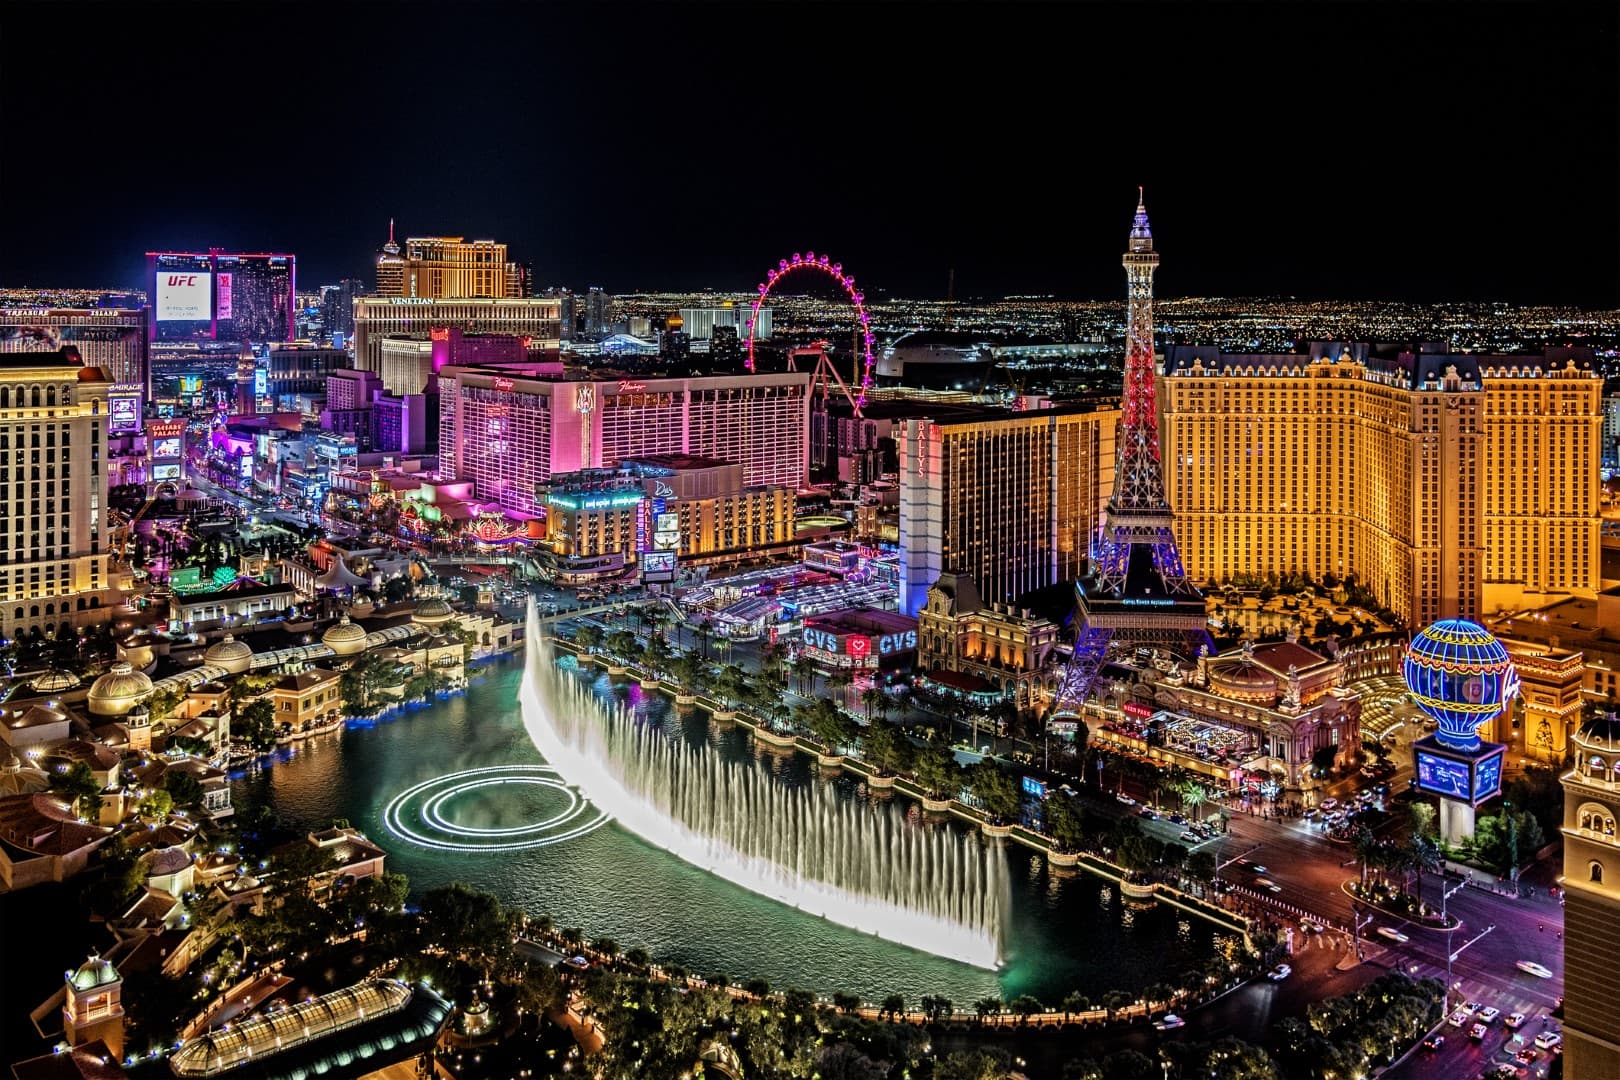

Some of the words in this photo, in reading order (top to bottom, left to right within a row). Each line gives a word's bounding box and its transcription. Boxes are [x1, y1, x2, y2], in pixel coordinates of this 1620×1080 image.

[168, 275, 197, 287] UFC
[391, 297, 434, 305] VENETIAN
[618, 380, 647, 392] Flamingo
[803, 628, 838, 653] CVS
[880, 630, 917, 654] CVS
